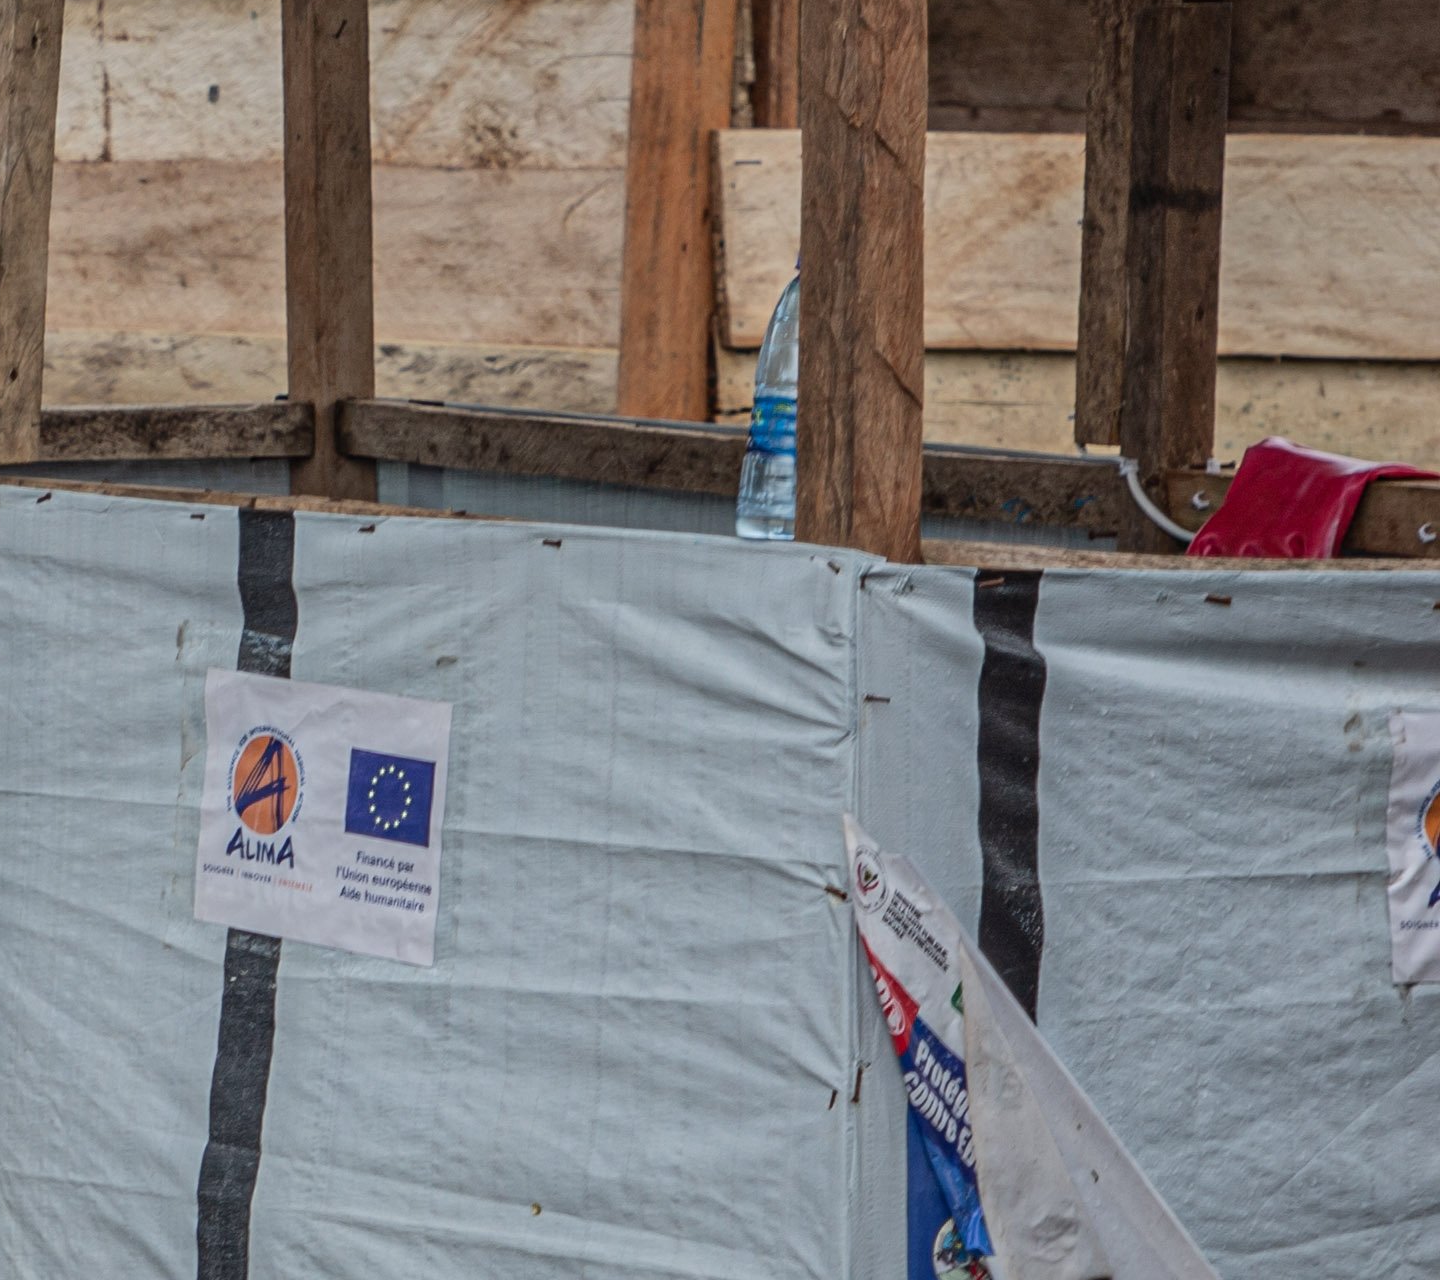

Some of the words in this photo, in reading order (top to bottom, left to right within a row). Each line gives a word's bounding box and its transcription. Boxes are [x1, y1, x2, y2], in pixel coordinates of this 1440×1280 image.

[225, 826, 295, 870] ALIMA
[356, 849, 396, 871] Financé
[397, 860, 414, 874] par
[371, 872, 433, 896] européenne
[339, 885, 362, 901] Aide
[364, 889, 426, 913] humanitaire
